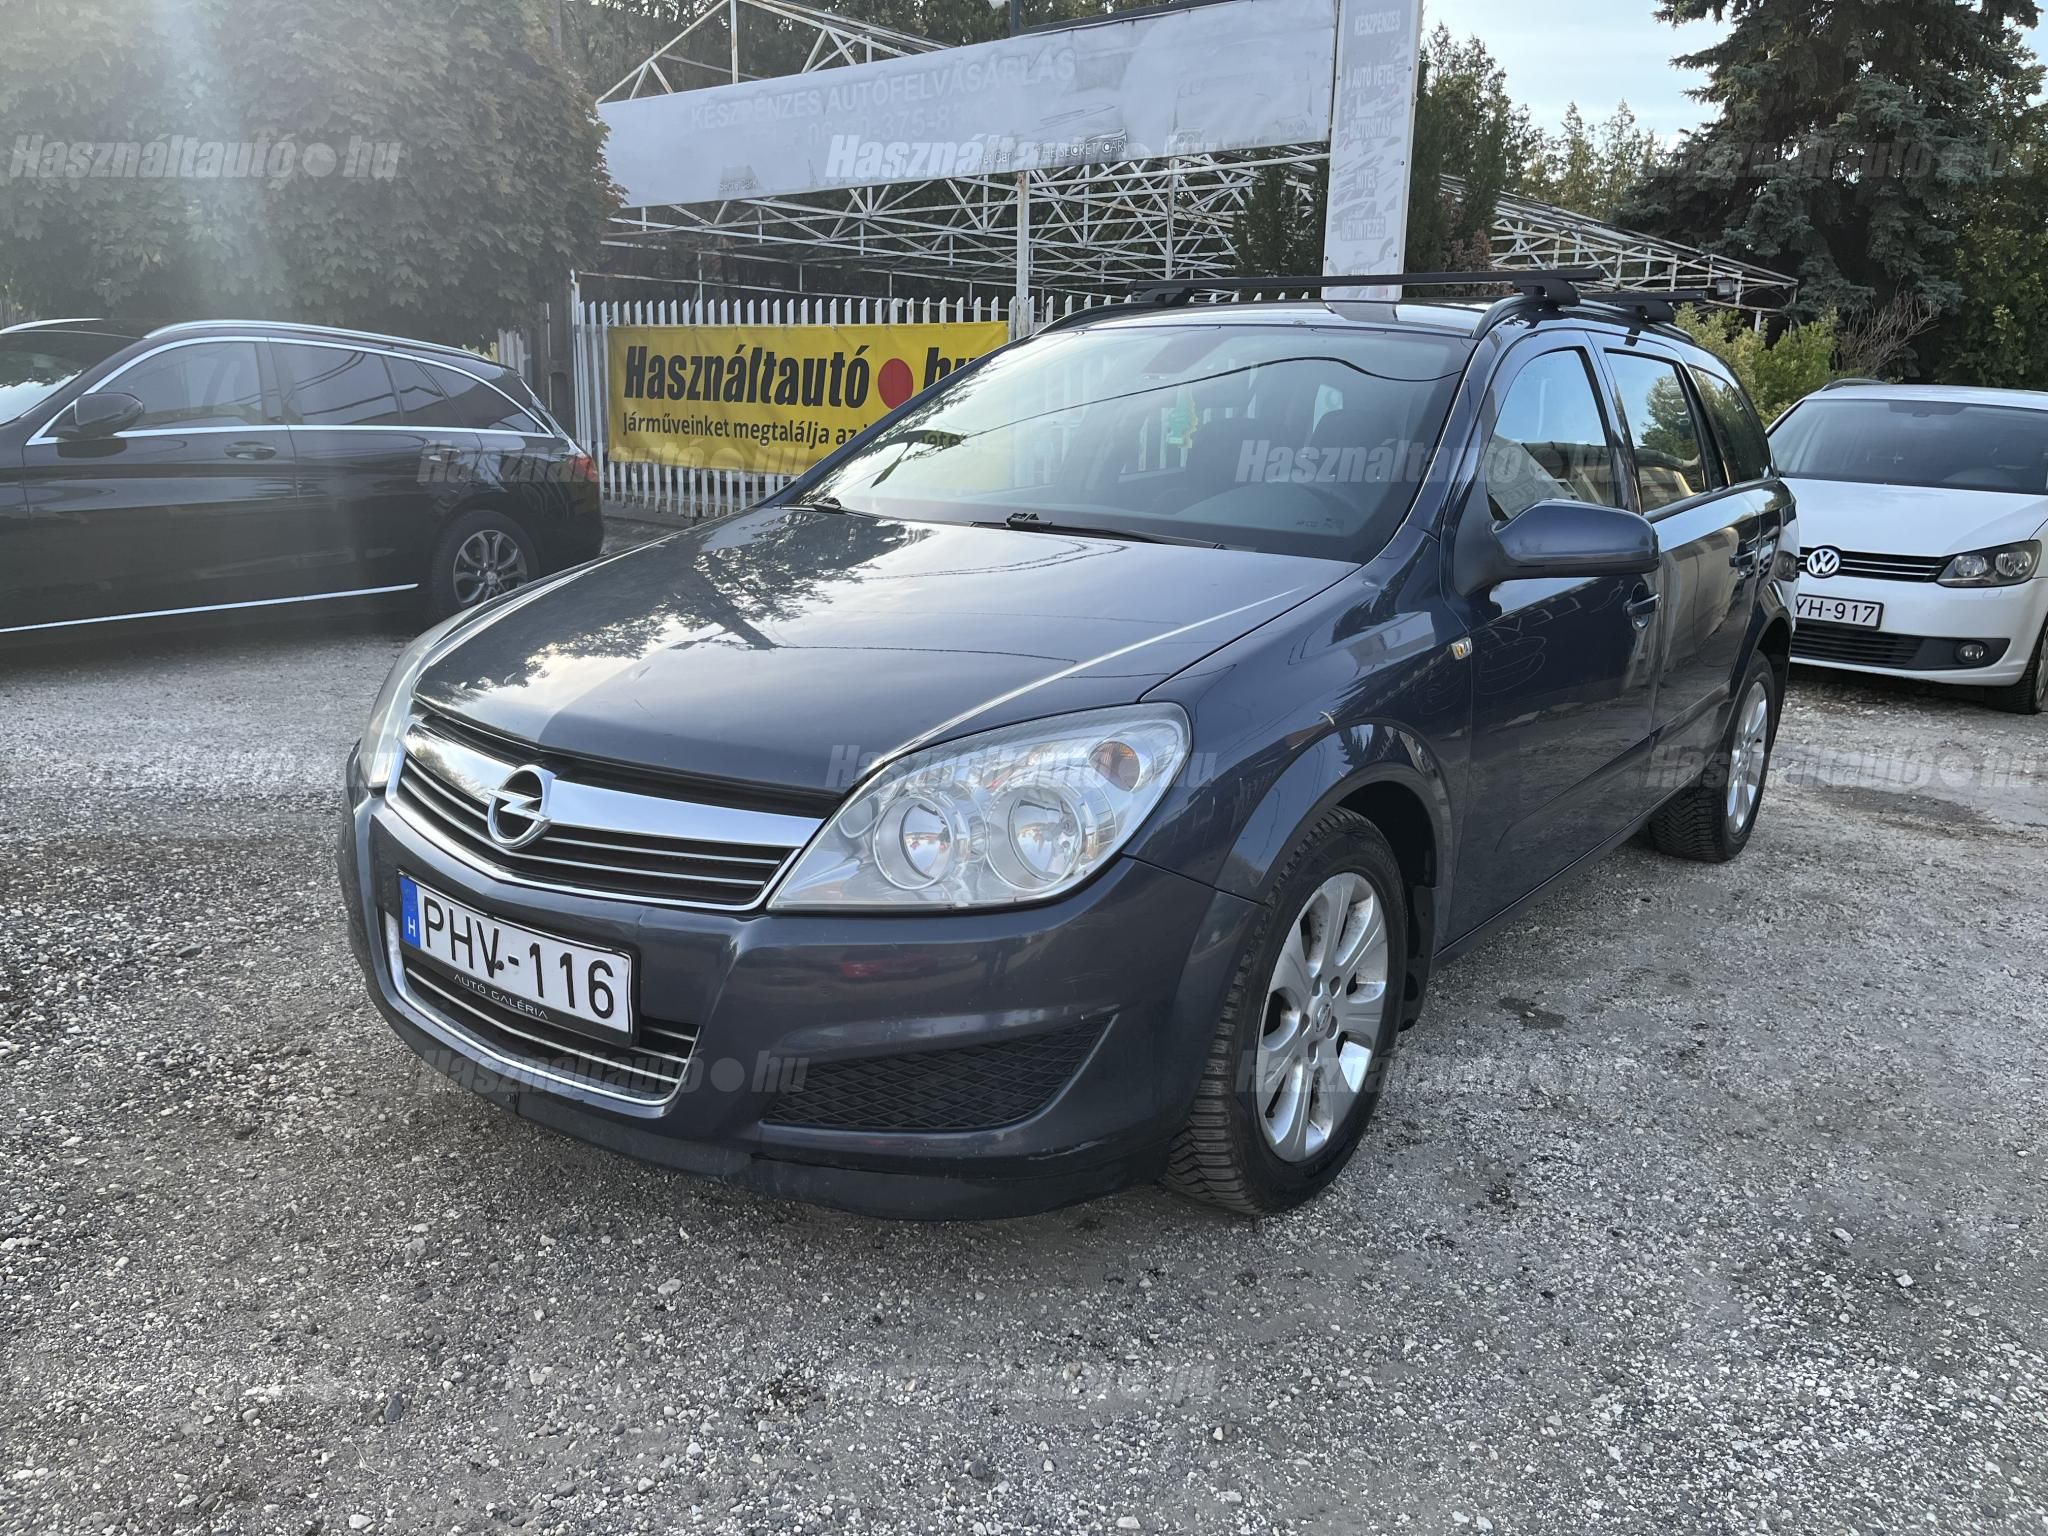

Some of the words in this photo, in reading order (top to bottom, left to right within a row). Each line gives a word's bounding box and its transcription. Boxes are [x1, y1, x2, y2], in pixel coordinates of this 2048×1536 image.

[623, 411, 730, 437] Járműveinket
[733, 420, 830, 450] megtalálja
[407, 915, 416, 937] H
[424, 895, 615, 1019] PHV-116
[491, 990, 549, 1021] GALÉRIA
